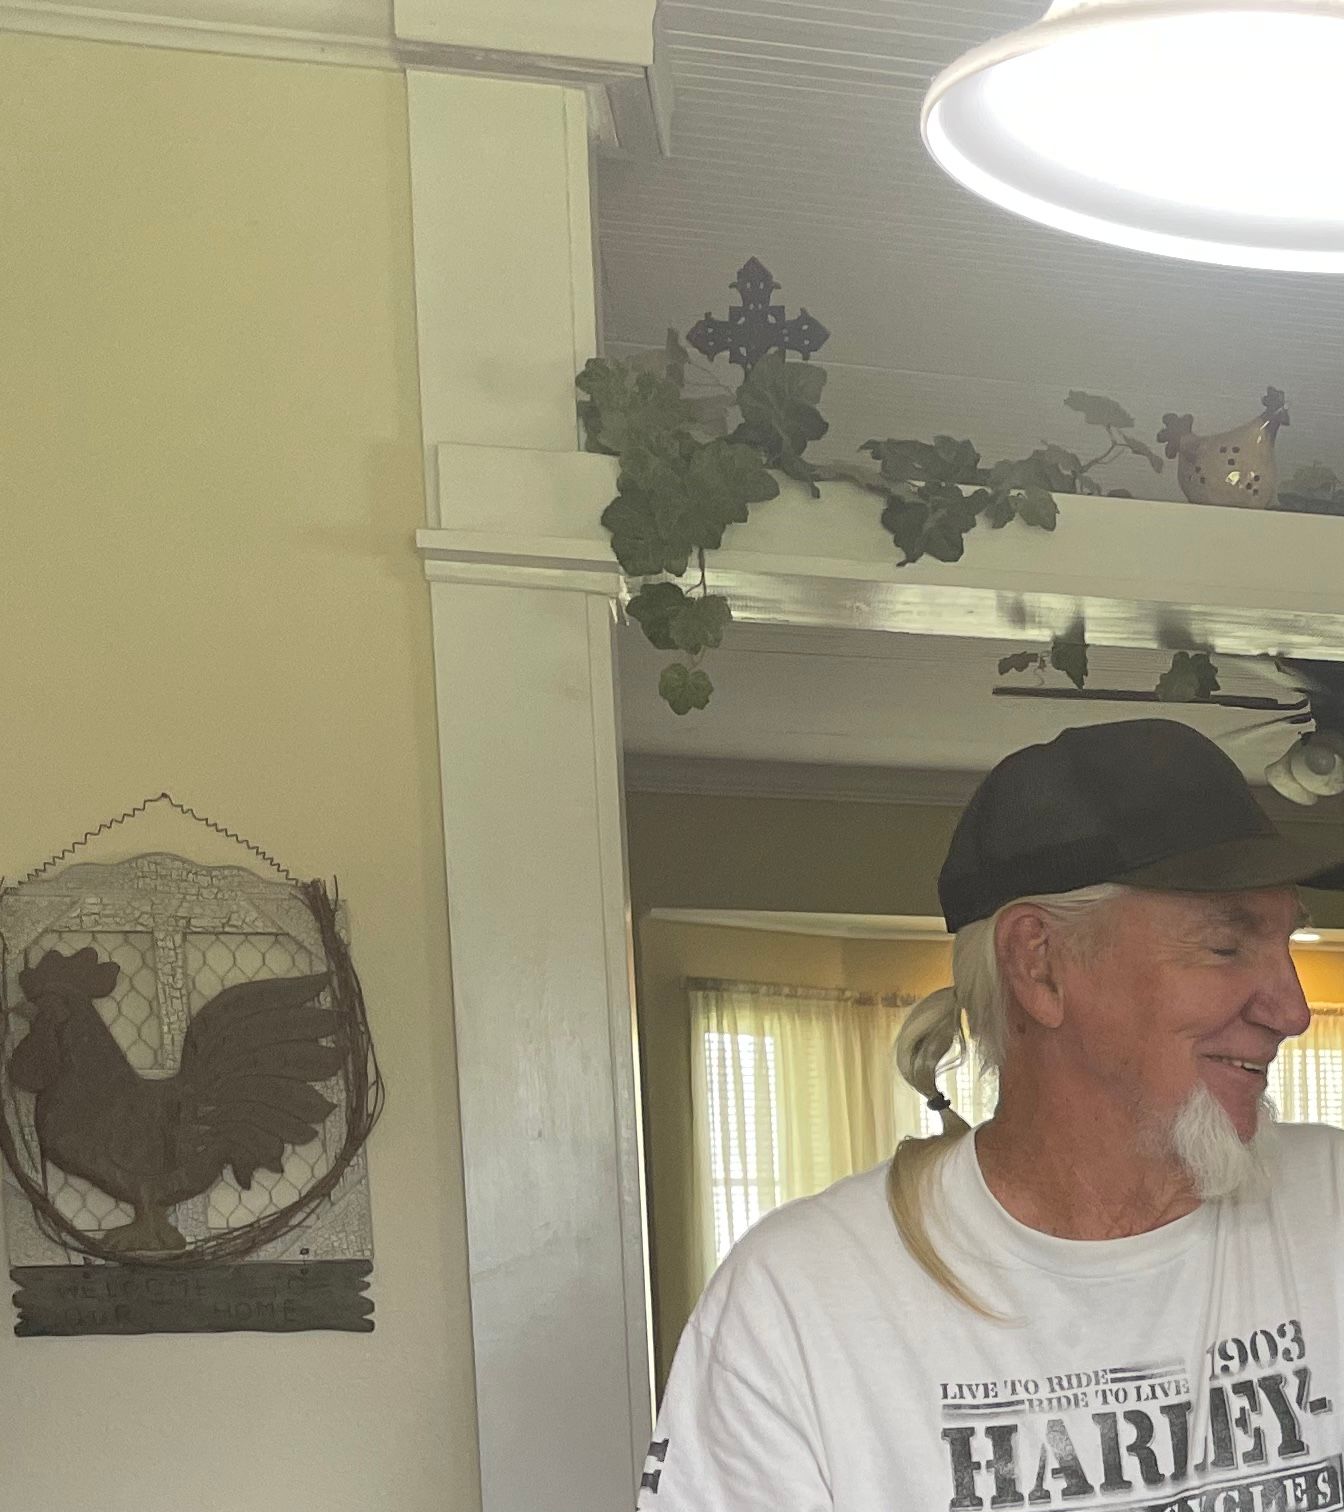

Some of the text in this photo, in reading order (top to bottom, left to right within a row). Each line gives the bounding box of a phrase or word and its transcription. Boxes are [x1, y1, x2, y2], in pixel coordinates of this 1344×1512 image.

[214, 1299, 299, 1323] HOME
[1208, 1318, 1308, 1382] 1903
[939, 1368, 1111, 1402] LIVE TO RIDE
[1026, 1376, 1192, 1415] RIDE TO LIVE
